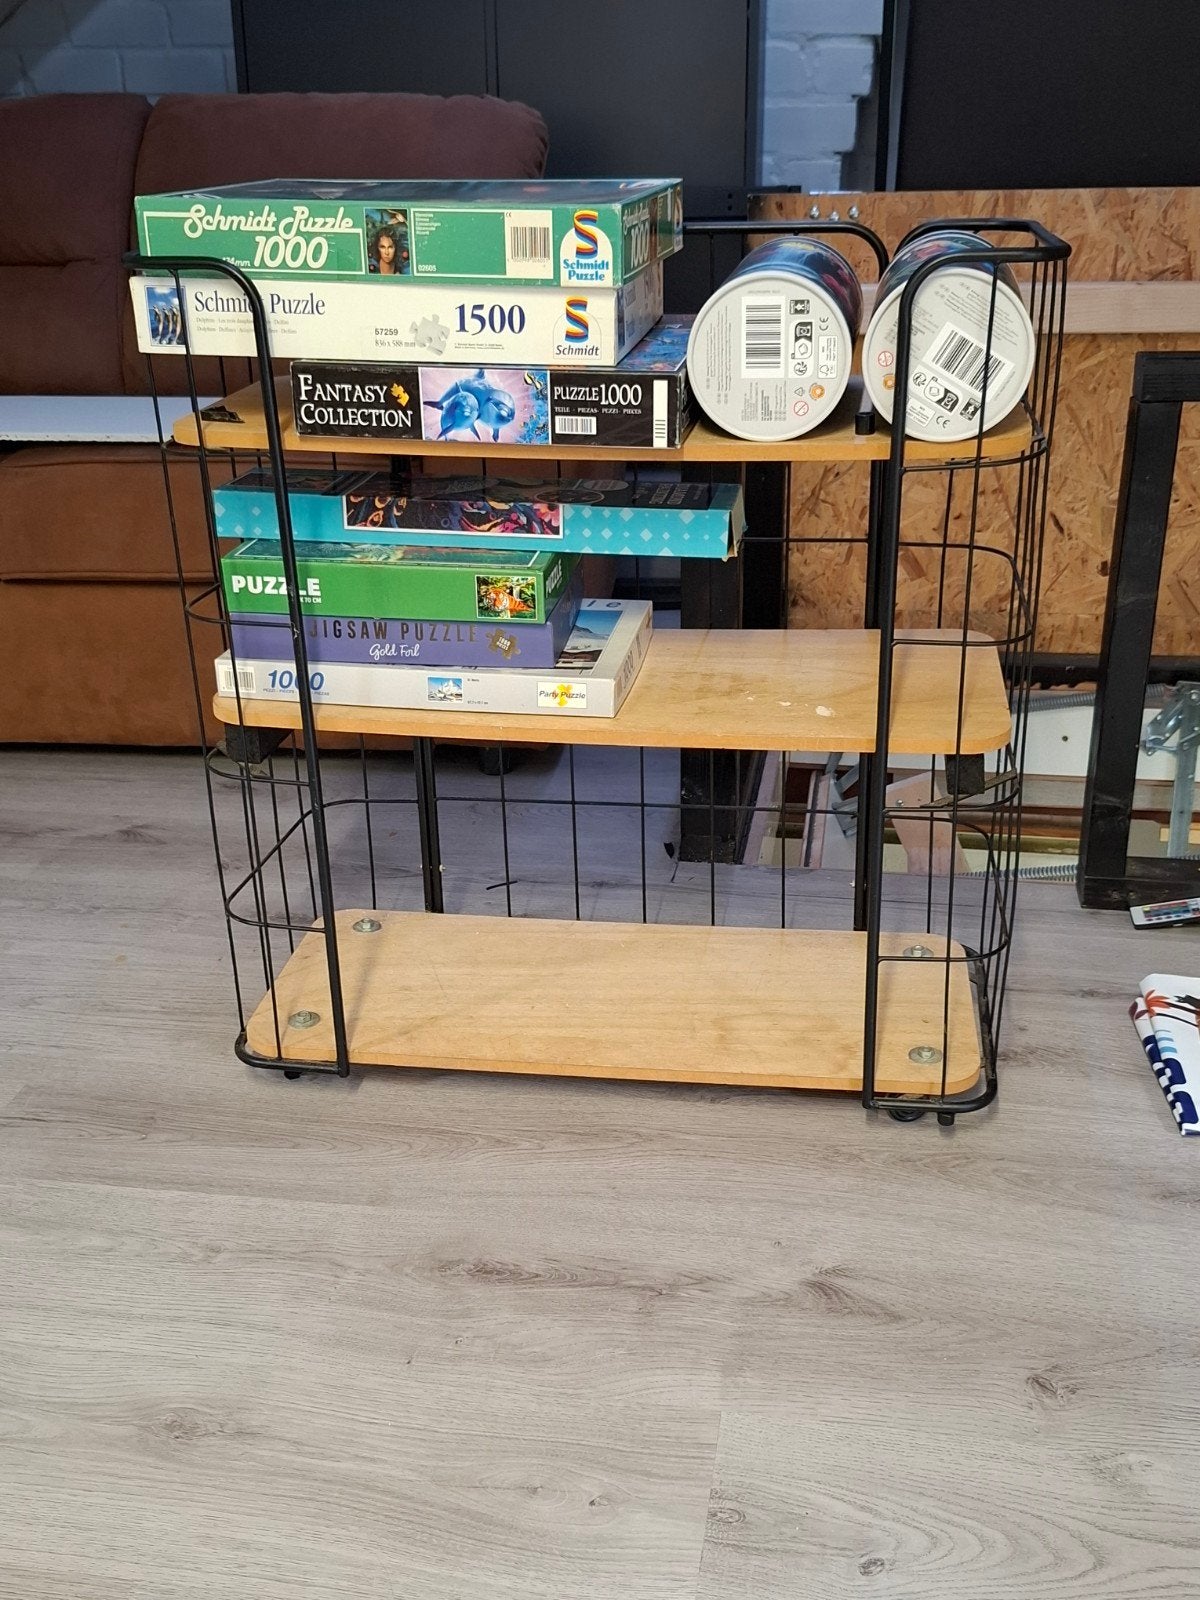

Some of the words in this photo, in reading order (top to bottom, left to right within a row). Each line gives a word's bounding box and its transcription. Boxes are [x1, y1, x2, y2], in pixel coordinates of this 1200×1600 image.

[183, 204, 277, 238] Schmidt
[279, 205, 354, 240] Puzzle
[253, 235, 329, 269] 1000
[563, 259, 609, 270] Schmidt
[568, 270, 605, 281] Puzzle
[194, 290, 264, 313] Schmi
[269, 292, 326, 315] Puzzle
[454, 303, 526, 336] 1500
[556, 345, 600, 357] Schmidt
[297, 374, 388, 403] FANTASY
[554, 386, 599, 401] PUZZLE
[599, 383, 642, 406] 1000
[300, 403, 413, 428] COLLECTION
[309, 619, 388, 640] JIGSAW
[401, 621, 478, 643] PUZZLE
[369, 643, 398, 661] Gold
[400, 644, 420, 658] Foil
[268, 669, 325, 691] 100
[539, 690, 559, 700] Party
[560, 690, 586, 700] Puzzle
